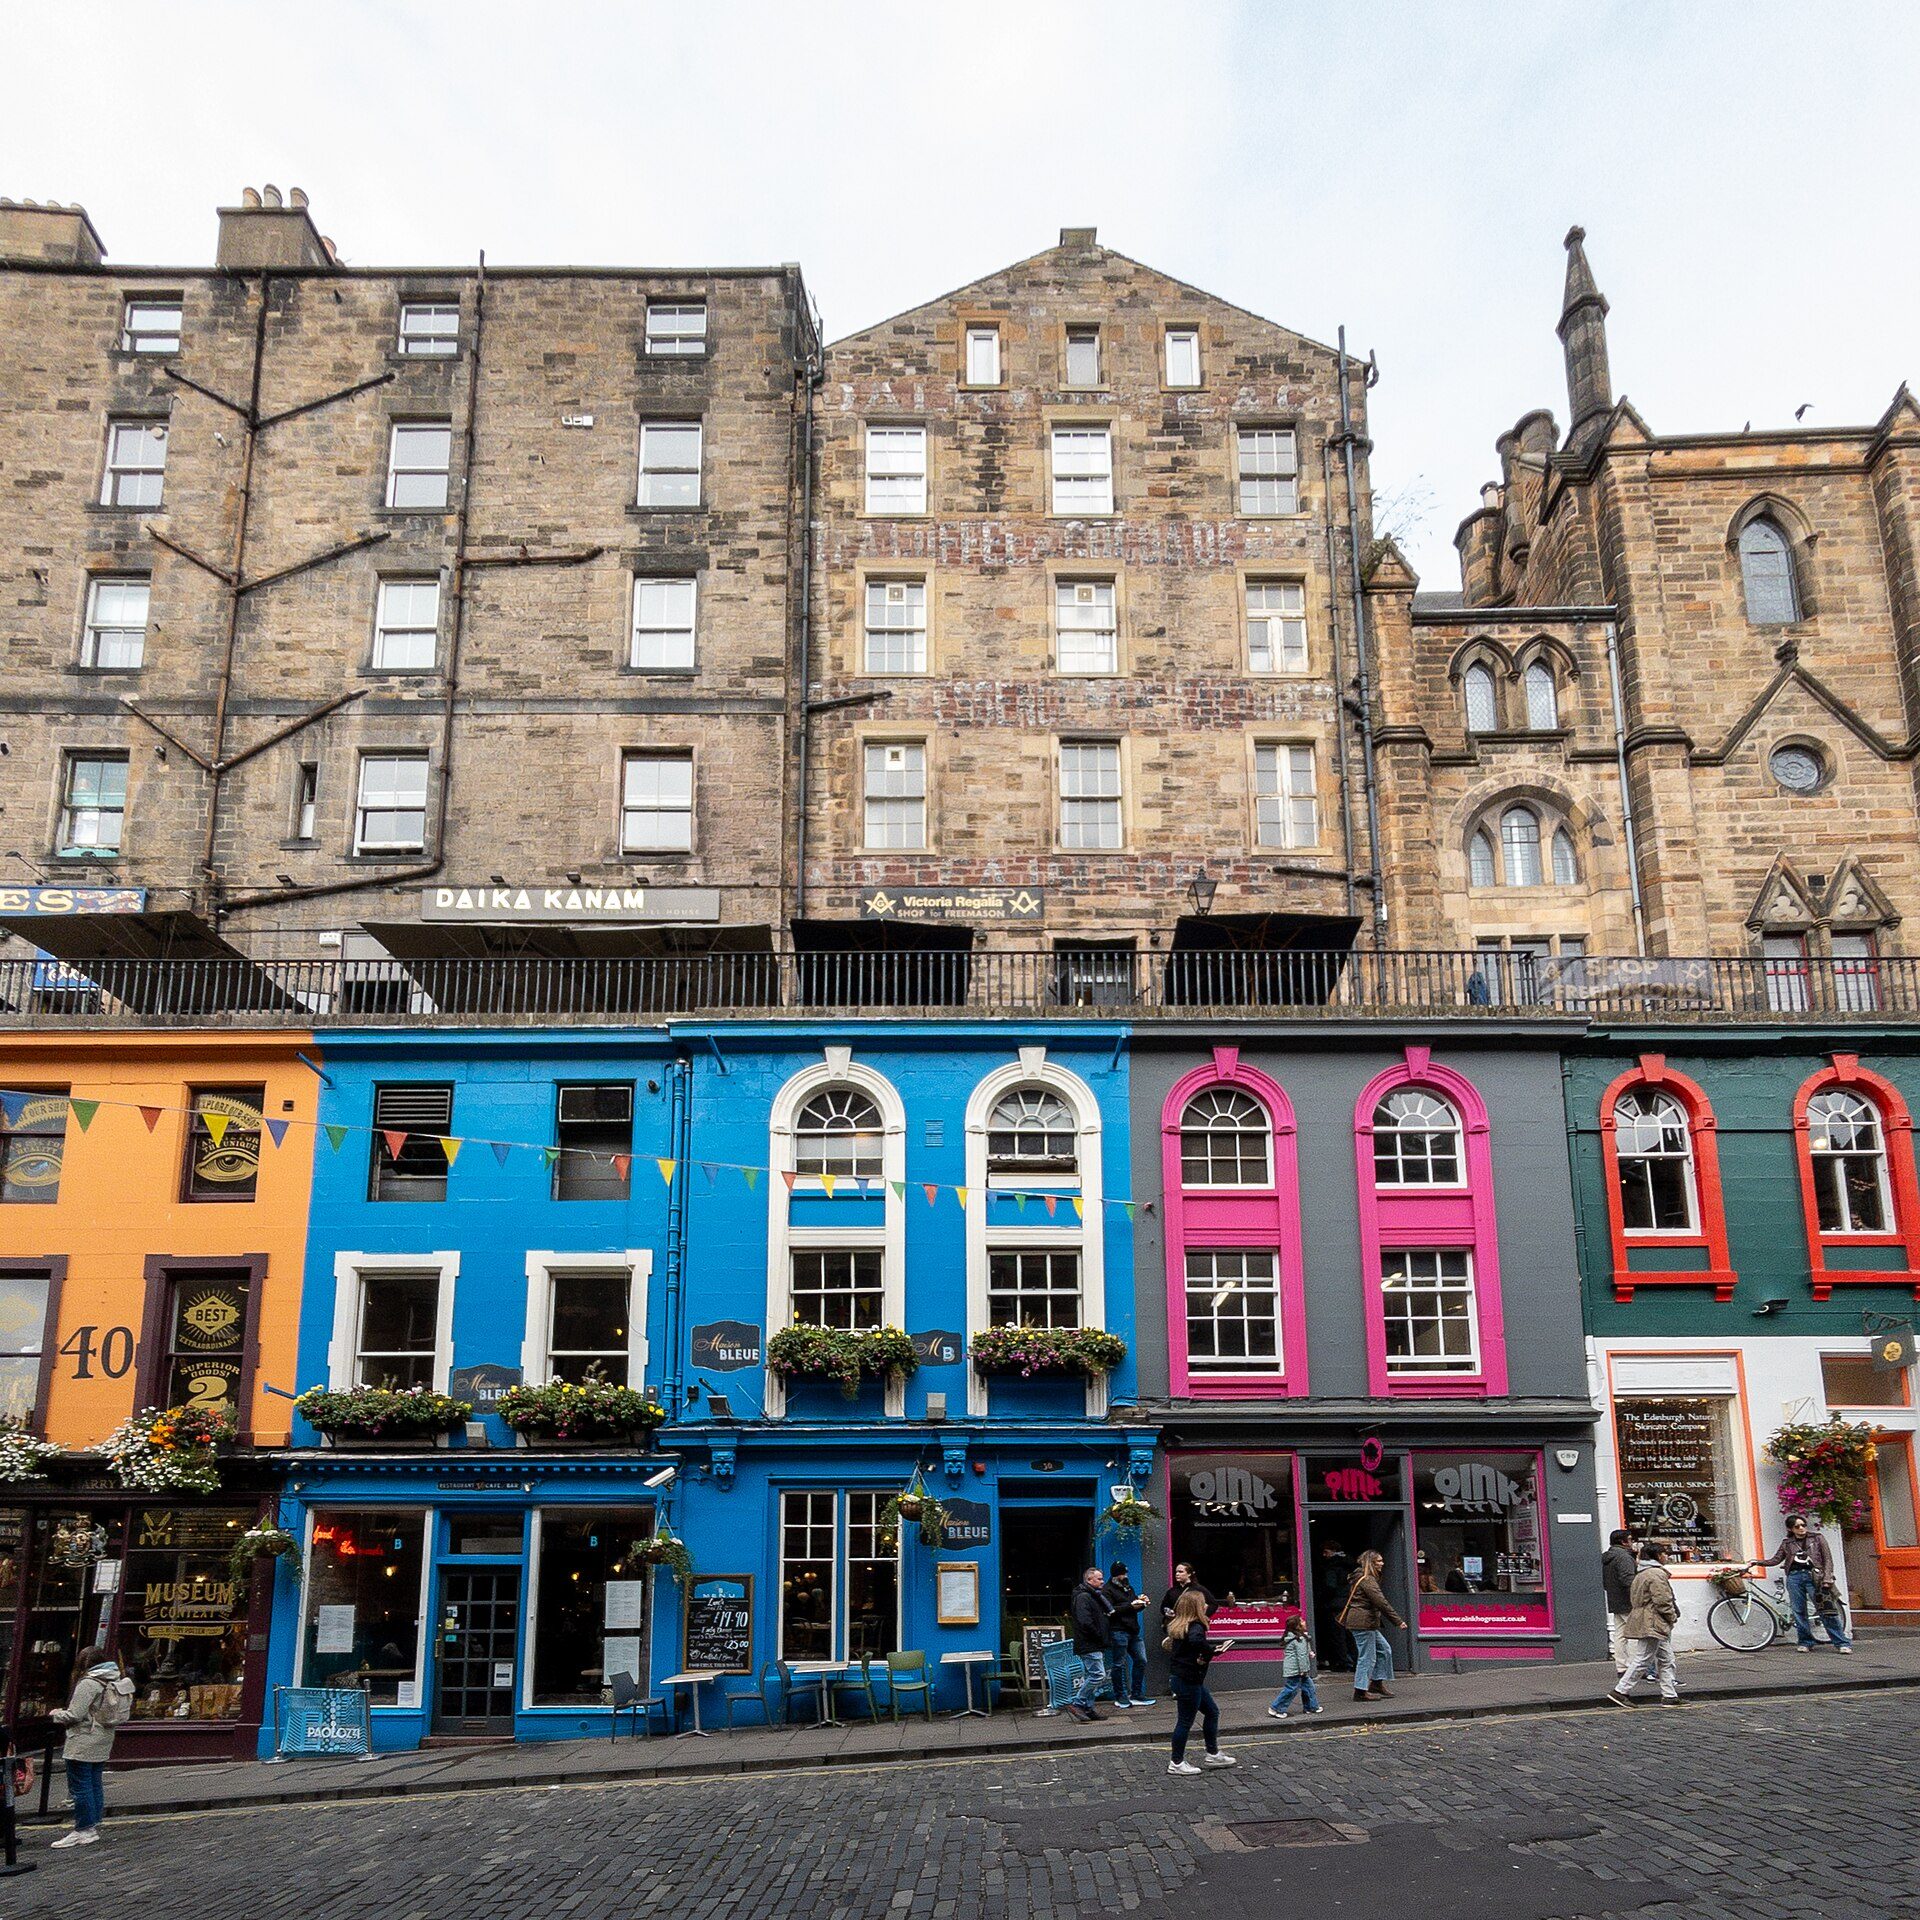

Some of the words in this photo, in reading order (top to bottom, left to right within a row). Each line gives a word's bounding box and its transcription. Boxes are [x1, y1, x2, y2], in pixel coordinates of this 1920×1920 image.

[436, 888, 532, 909] DAIKA
[544, 888, 645, 909] KANAM
[903, 896, 953, 907] Victoria
[955, 896, 1004, 909] Regalia
[897, 909, 926, 918] SHOP
[930, 909, 942, 918] for
[944, 909, 1005, 918] FREEMASON
[1586, 960, 1659, 976] SHOP
[1554, 982, 1698, 999] FREEMASONS
[29, 1105, 47, 1117] OUR
[202, 1143, 217, 1153] TH
[222, 1139, 259, 1151] UNIQUE
[195, 1309, 229, 1322] BEST
[702, 1333, 741, 1351] Maison
[60, 1326, 134, 1380] 40
[719, 1348, 759, 1361] BLEUE
[180, 1361, 240, 1375] SUPERIOR
[191, 1369, 230, 1378] GOODS!
[185, 1376, 228, 1412] 2
[1624, 1413, 1640, 1421] The
[1643, 1413, 1685, 1423] Edinburgh
[1688, 1413, 1718, 1421] Natural
[1635, 1422, 1669, 1431] Skincare
[939, 1511, 969, 1528] Maison
[948, 1526, 988, 1539] BLEUE
[145, 1583, 235, 1606] MUSEUM
[160, 1606, 215, 1618] CONTEXT
[1210, 1617, 1279, 1625] .oinkhogroast.co.uk
[1442, 1615, 1527, 1624] www.oinkhogroast.co.uk
